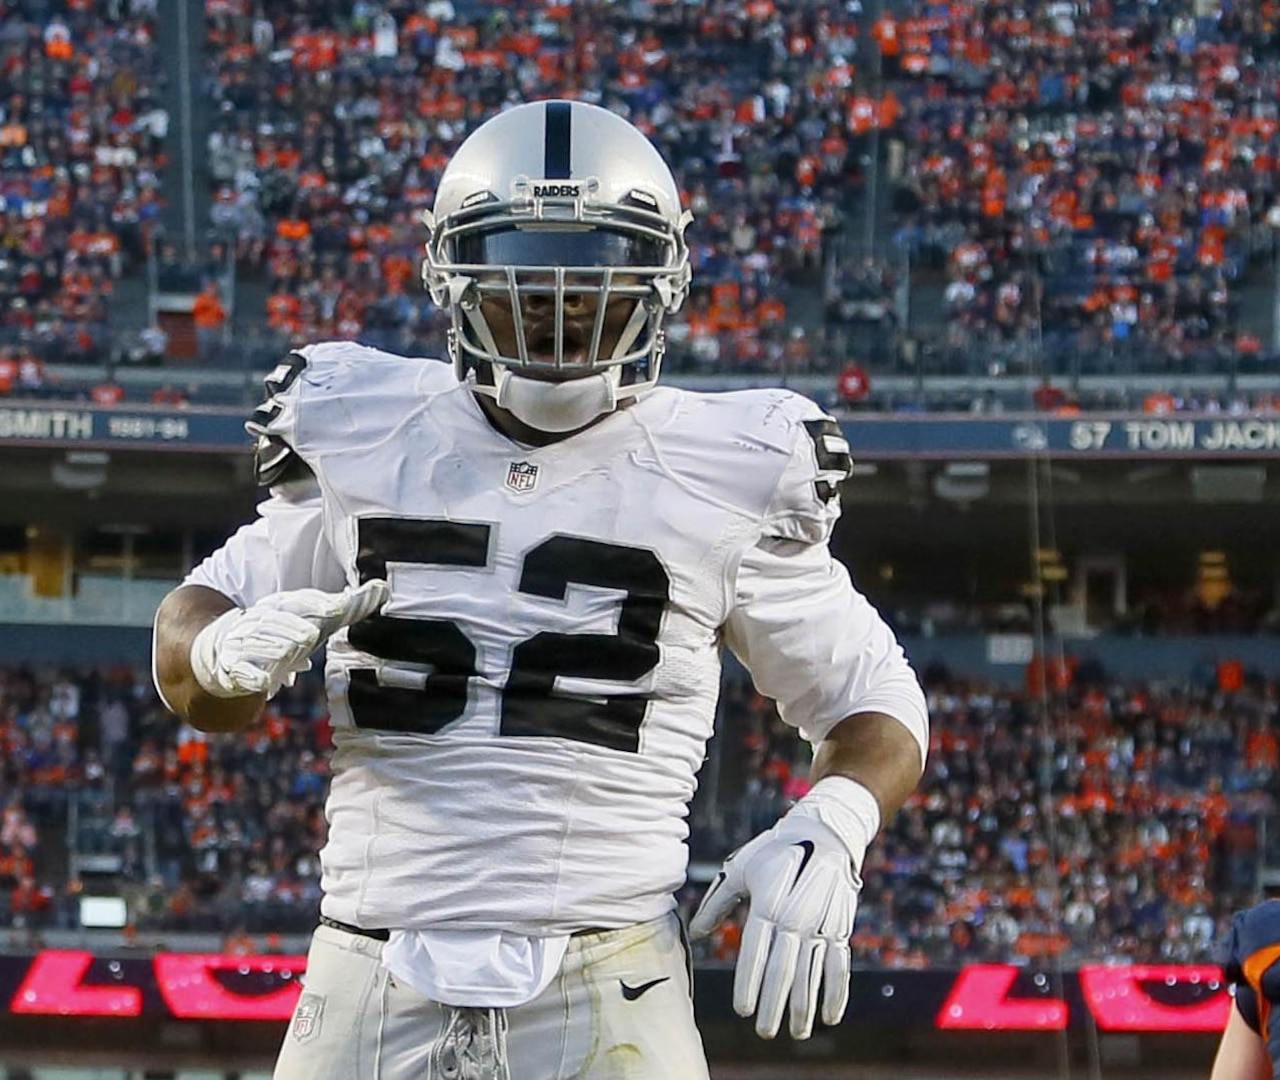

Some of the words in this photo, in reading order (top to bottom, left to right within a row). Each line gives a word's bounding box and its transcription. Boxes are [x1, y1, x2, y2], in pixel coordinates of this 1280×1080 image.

[533, 185, 580, 198] RAIDERS
[1069, 420, 1111, 450] 57
[1125, 420, 1195, 450] TOM
[510, 472, 532, 488] NFL
[344, 514, 673, 755] 52
